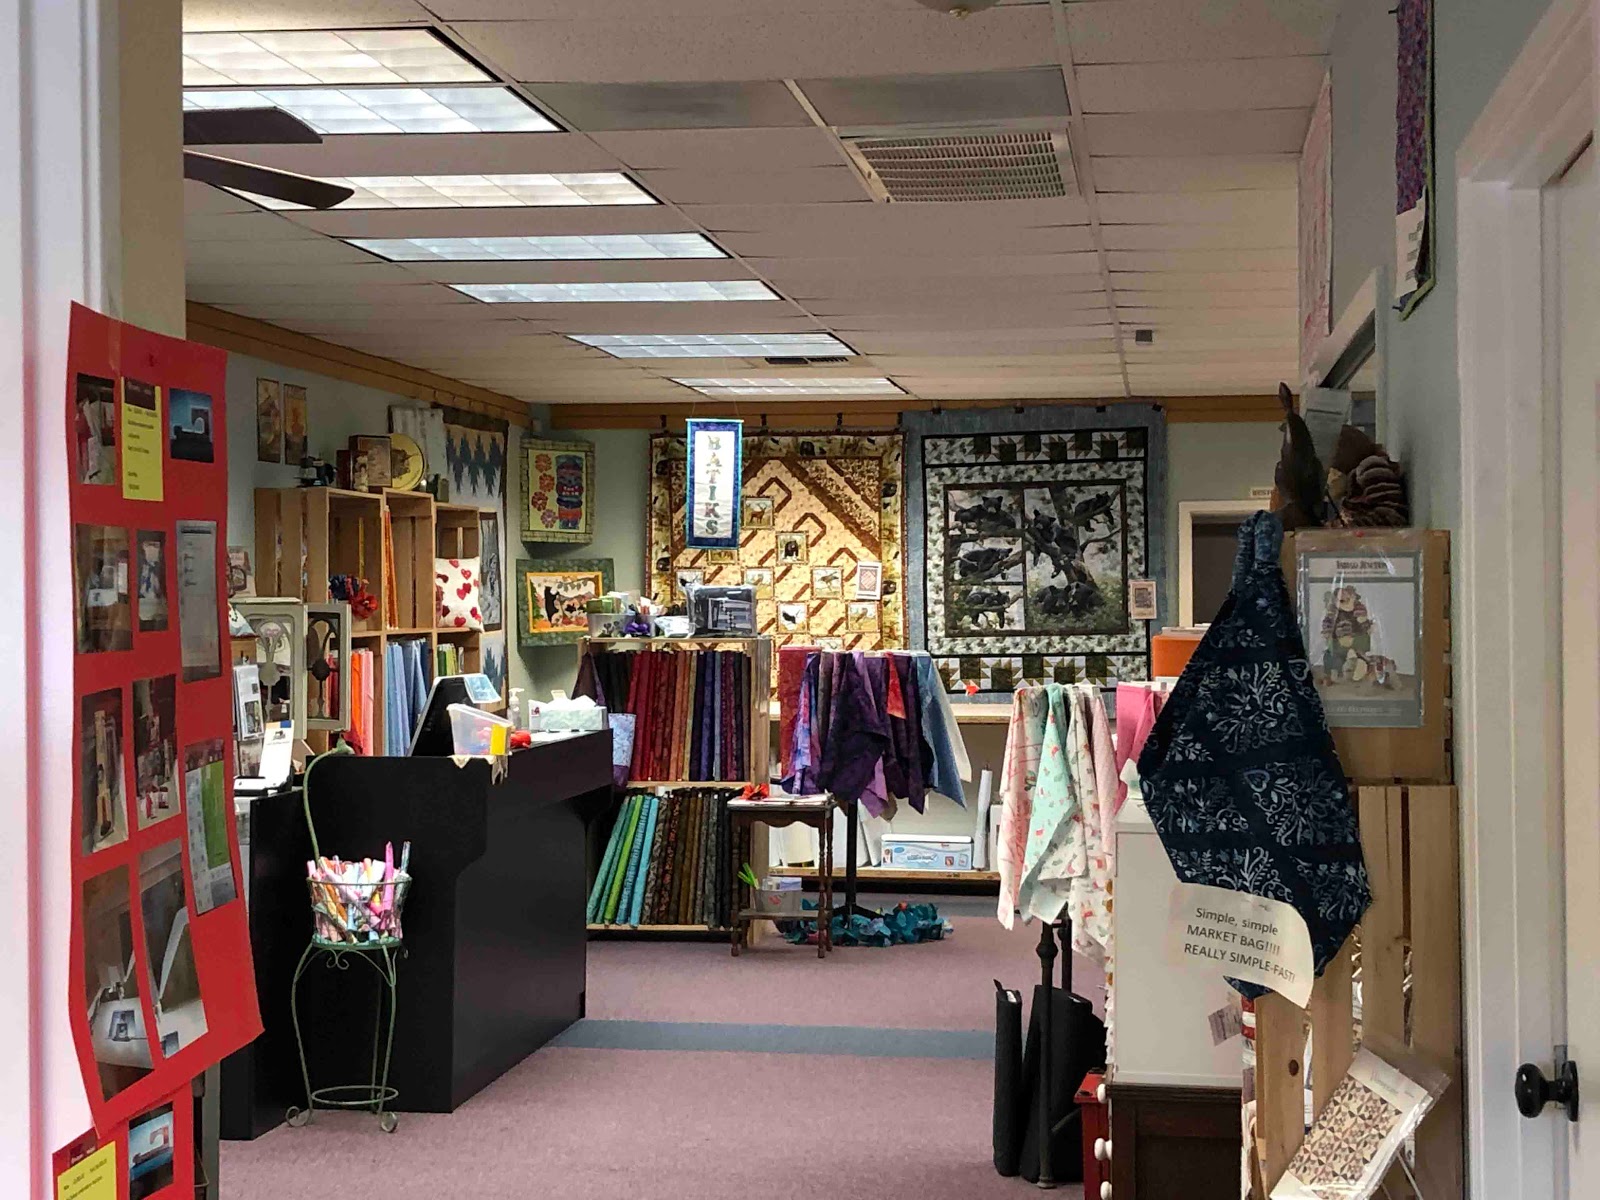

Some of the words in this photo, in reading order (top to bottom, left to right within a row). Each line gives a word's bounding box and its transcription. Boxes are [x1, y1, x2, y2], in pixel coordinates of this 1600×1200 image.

[705, 435, 723, 536] BATIKS
[1195, 907, 1238, 927] Simple,
[1241, 918, 1279, 936] simple
[1186, 924, 1238, 944] MARKET
[1239, 935, 1281, 956] BAG!!!!
[1184, 943, 1227, 961] REALLY
[1228, 951, 1296, 983] SIMPLE-FAST!
